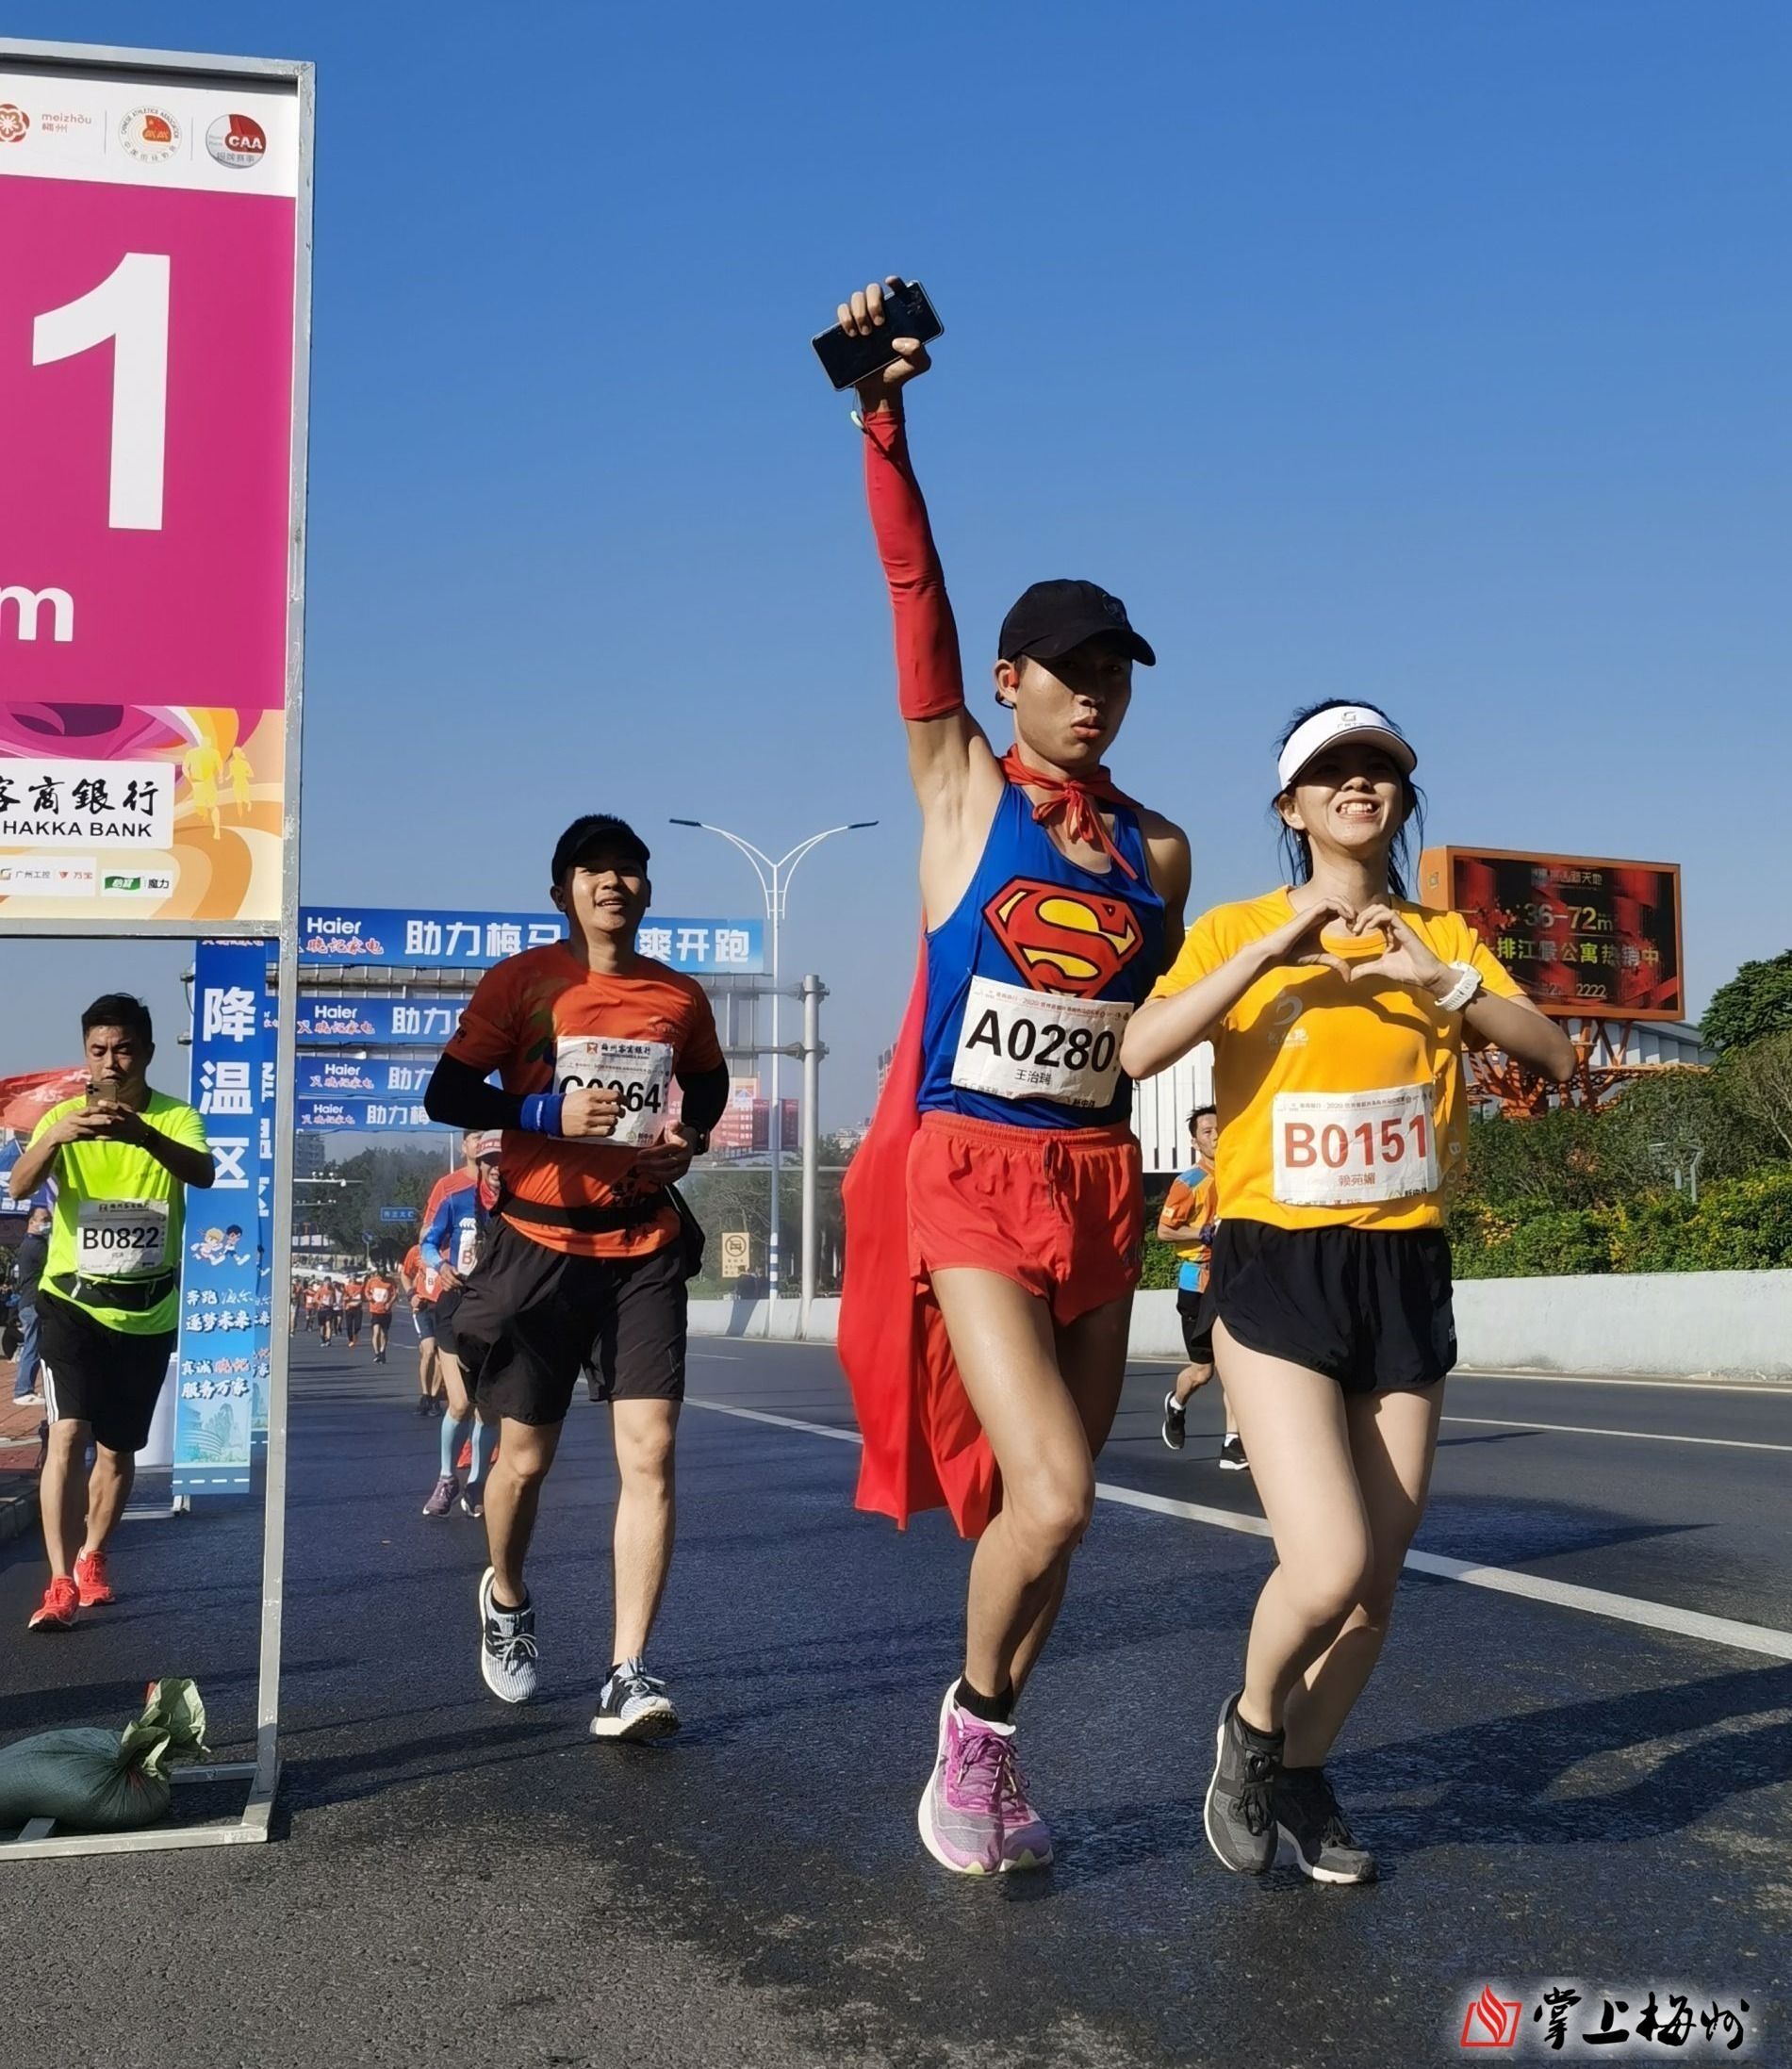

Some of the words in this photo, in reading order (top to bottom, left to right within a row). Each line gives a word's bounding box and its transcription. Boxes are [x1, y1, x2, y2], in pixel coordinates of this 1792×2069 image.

[228, 136, 263, 150] CAA
[32, 252, 171, 531] 1
[3, 820, 83, 837] HAKKA
[90, 822, 153, 838] BANK
[148, 879, 170, 890] 魔力
[306, 916, 362, 935] Haier
[404, 920, 562, 958] 助力梅马
[638, 927, 750, 963] 爽开跑
[314, 1005, 358, 1019] Haier
[391, 1006, 464, 1035] 助力
[965, 1009, 1116, 1073] A0280
[324, 1063, 362, 1076] Haier
[199, 986, 256, 1189] 降温区
[559, 1075, 661, 1113] C64
[313, 1103, 344, 1115] Haier
[1285, 1114, 1427, 1169] B0151
[83, 1227, 159, 1249] B0822
